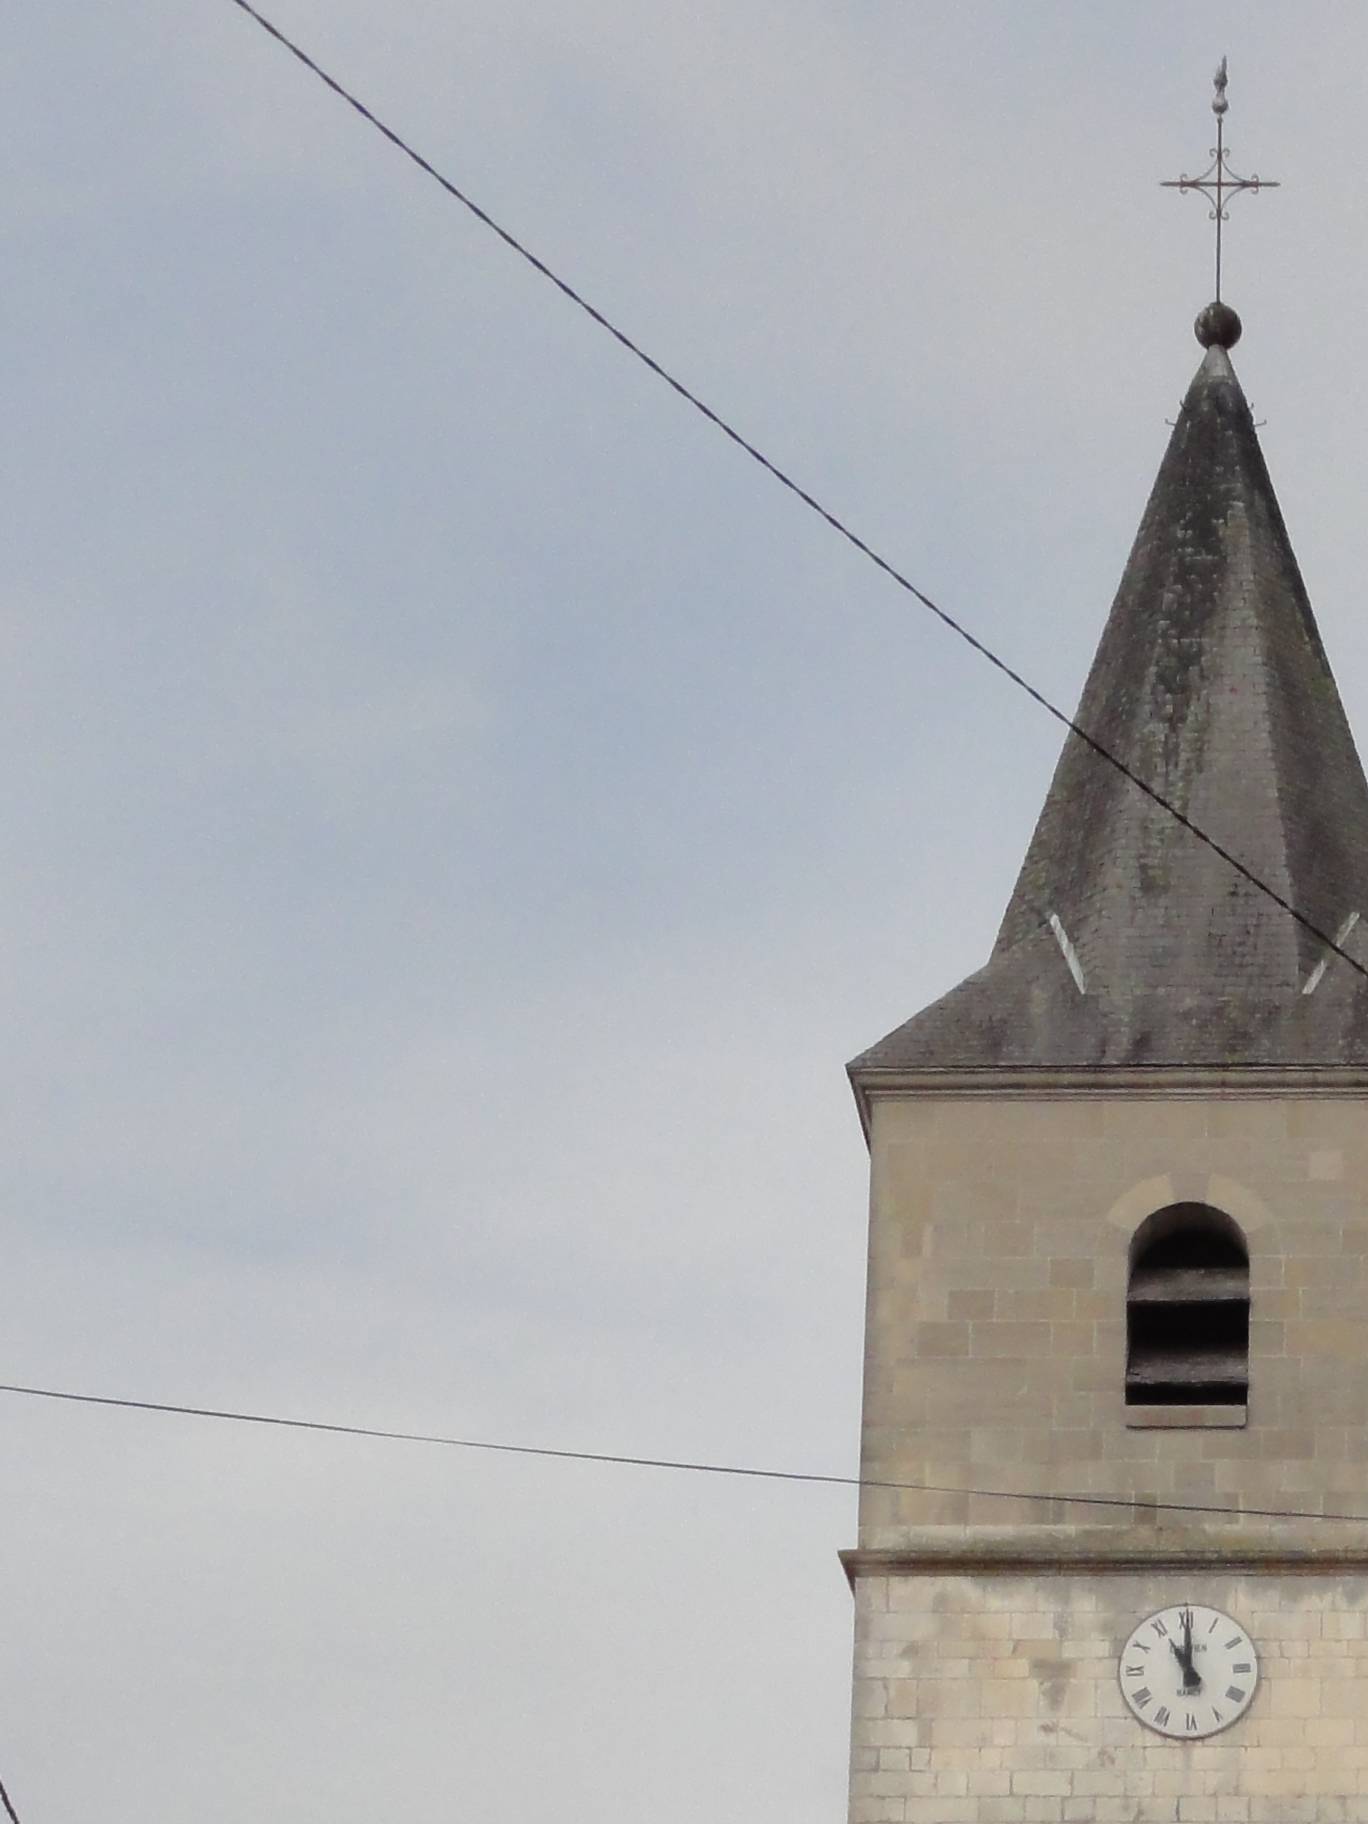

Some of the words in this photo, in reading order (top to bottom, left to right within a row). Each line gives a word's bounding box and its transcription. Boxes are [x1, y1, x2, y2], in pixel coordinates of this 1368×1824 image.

[1151, 1619, 1168, 1639] XI
[1178, 1611, 1194, 1630] XI
[1208, 1617, 1219, 1634] I
[1132, 1641, 1151, 1654] X
[1223, 1636, 1242, 1650] II
[1126, 1665, 1144, 1676] IX
[1232, 1663, 1251, 1673] III
[1186, 1713, 1198, 1730] VI
[1211, 1704, 1224, 1722] V
